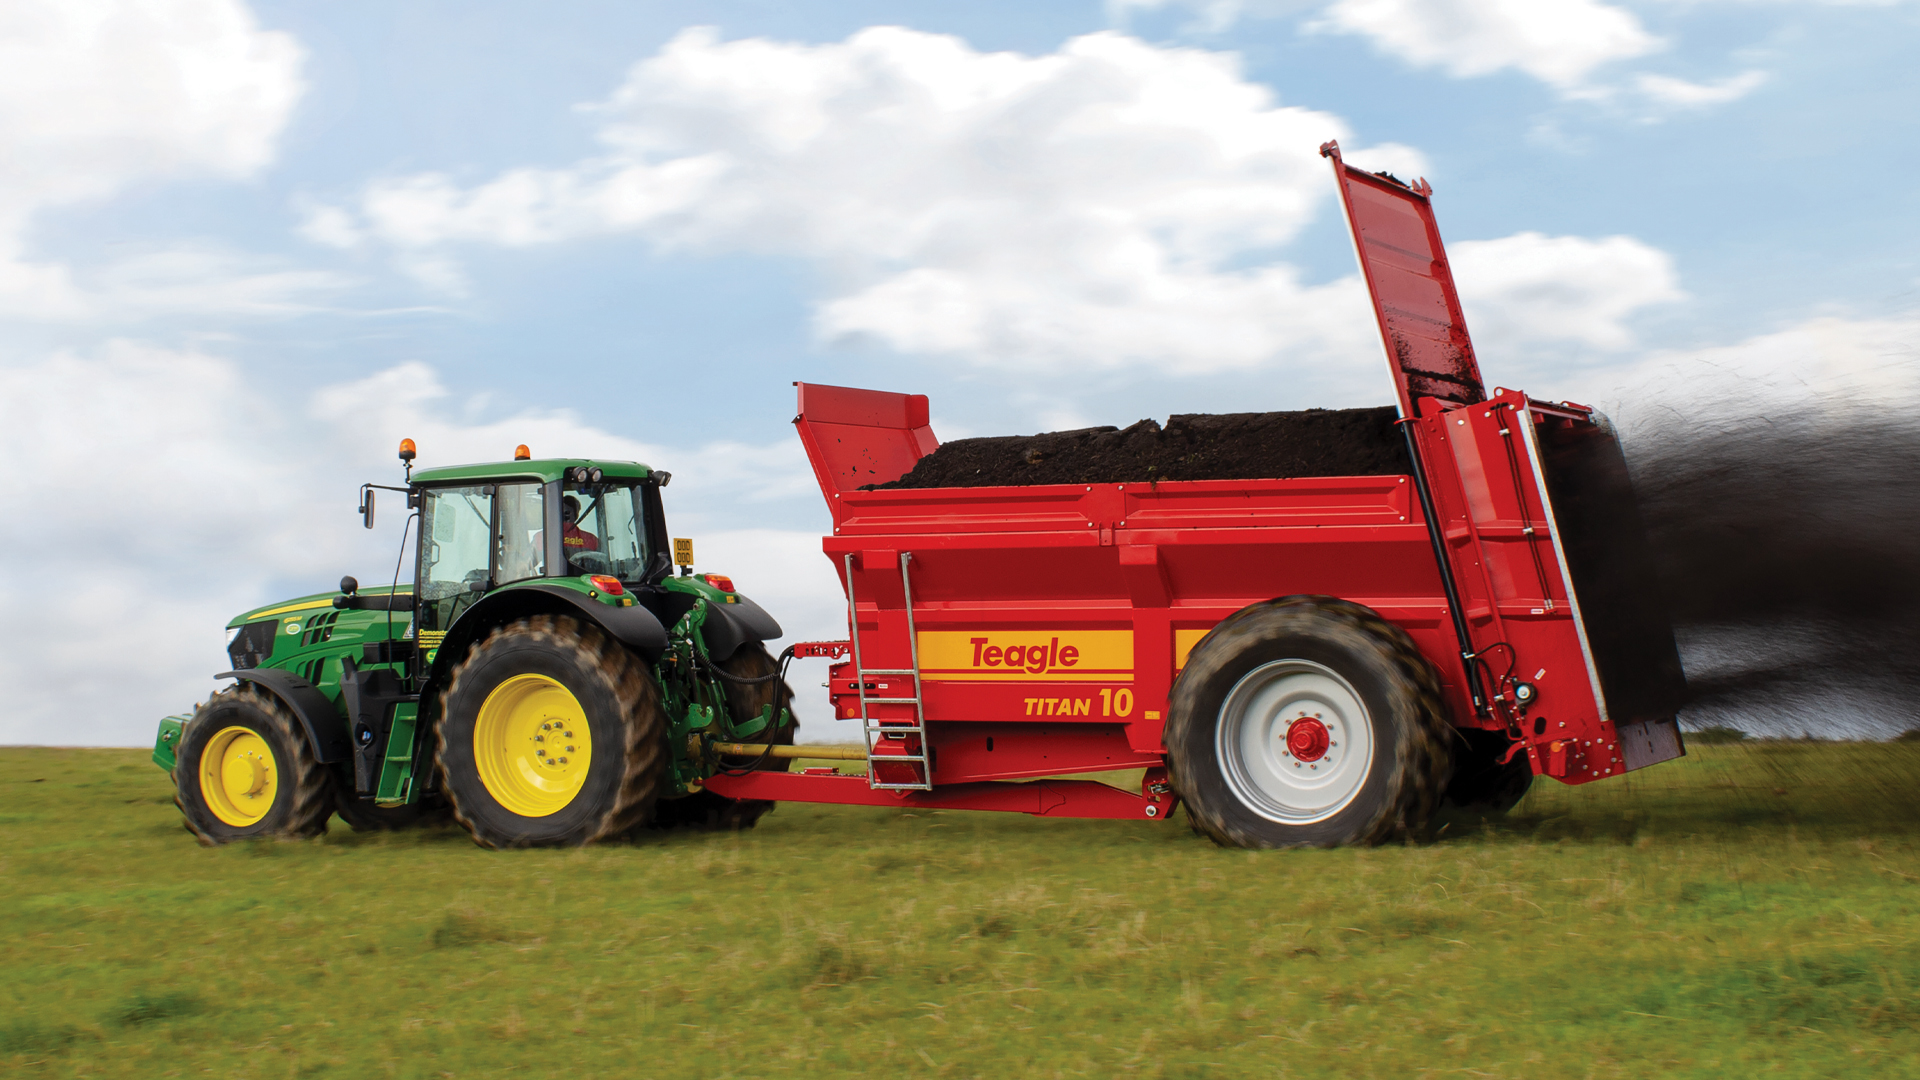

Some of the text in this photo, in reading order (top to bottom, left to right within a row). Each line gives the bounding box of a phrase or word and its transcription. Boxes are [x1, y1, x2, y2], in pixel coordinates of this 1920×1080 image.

[970, 637, 1079, 674] Teagle
[1024, 688, 1134, 717] TITAN 10
